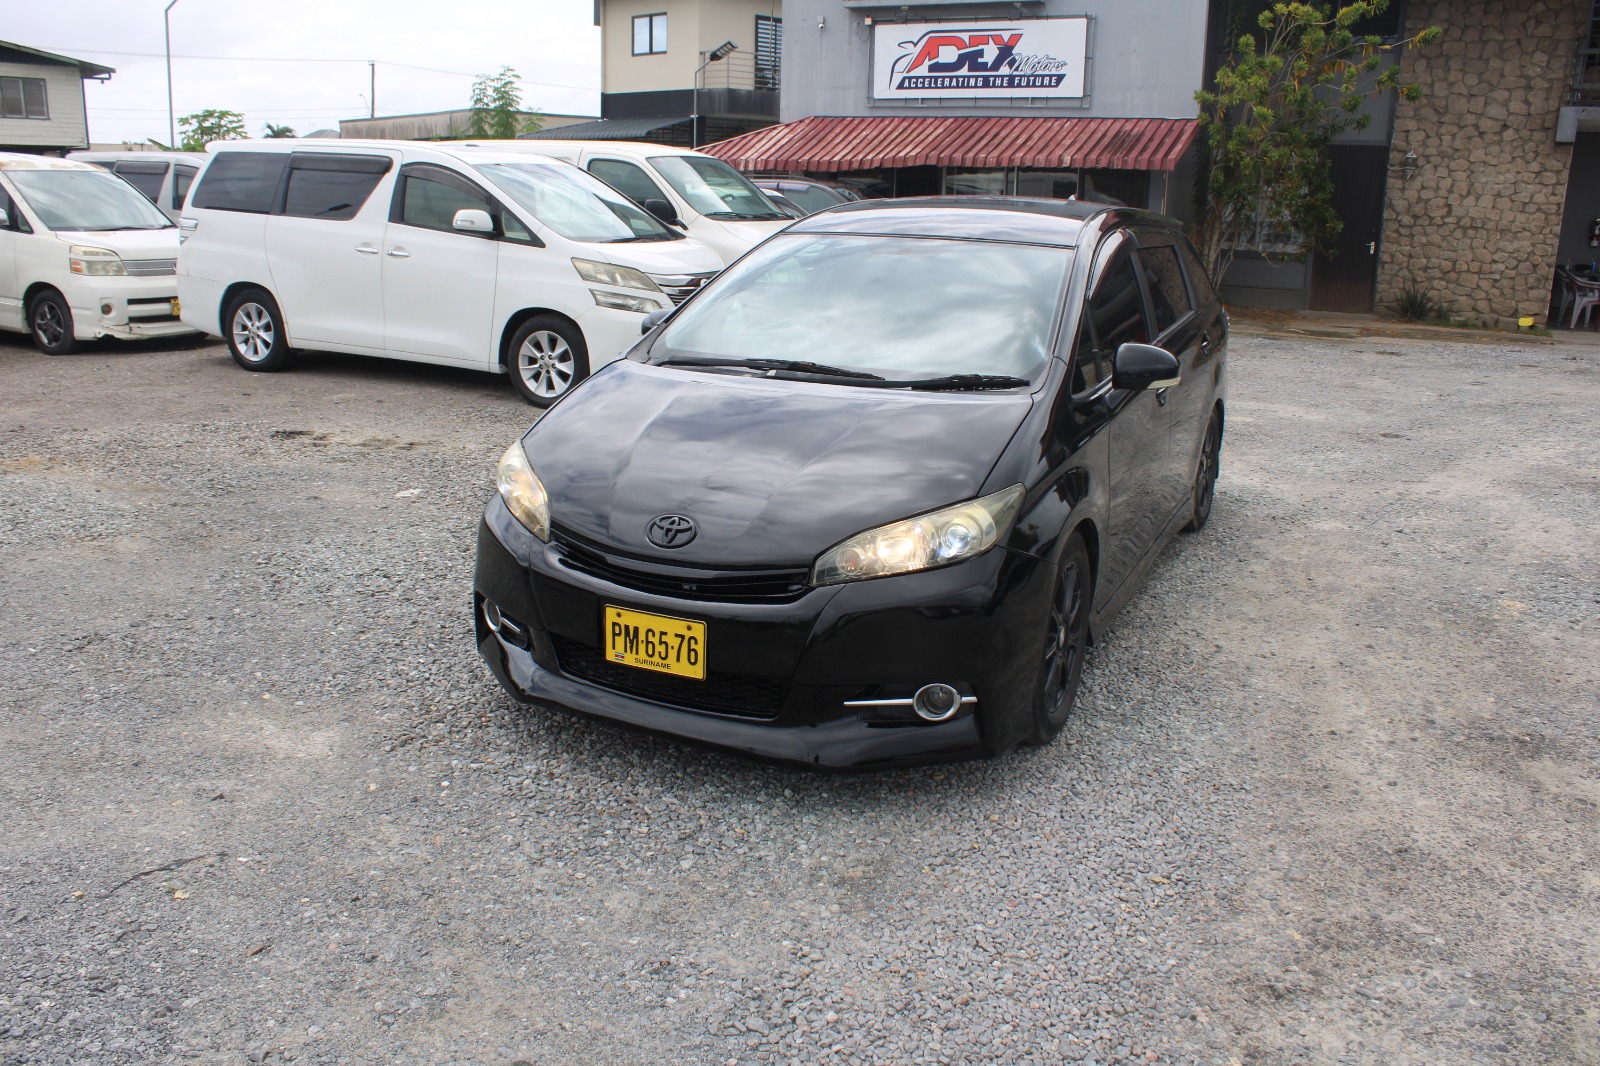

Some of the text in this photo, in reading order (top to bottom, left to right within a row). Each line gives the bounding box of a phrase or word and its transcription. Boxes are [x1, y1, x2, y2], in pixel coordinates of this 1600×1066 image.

[1003, 53, 1068, 75] Motors
[903, 76, 1058, 88] ACCELERATING THE FUTURE
[634, 657, 672, 670] SURINAME
